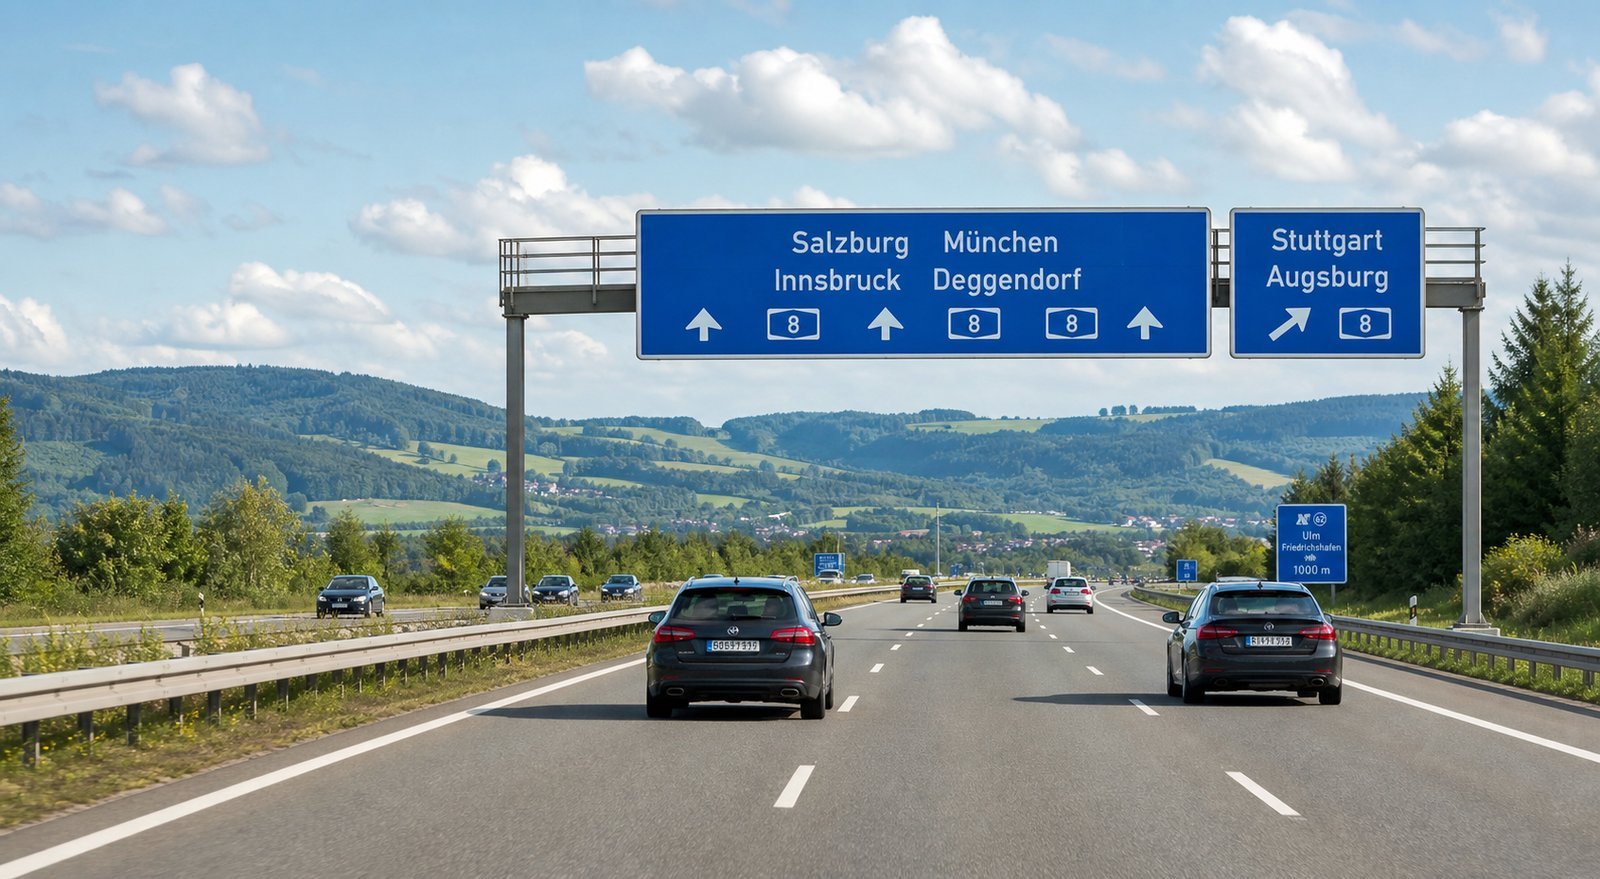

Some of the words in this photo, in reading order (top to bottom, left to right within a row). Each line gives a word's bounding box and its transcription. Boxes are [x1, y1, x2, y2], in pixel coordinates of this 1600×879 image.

[792, 230, 909, 260] Salzburg
[944, 230, 1058, 253] München
[1271, 228, 1383, 257] Stuttgart
[775, 268, 901, 291] Innsbruck
[933, 267, 1082, 297] Deggendorf
[1266, 264, 1388, 294] Augsburg
[787, 315, 800, 334] 8
[968, 314, 980, 333] 8
[1066, 314, 1078, 333] 8
[1359, 314, 1372, 333] 8
[1302, 531, 1320, 540] Ulm
[1281, 543, 1342, 552] Friedrichshafen
[1294, 564, 1318, 575] 1000
[1321, 567, 1331, 575] m
